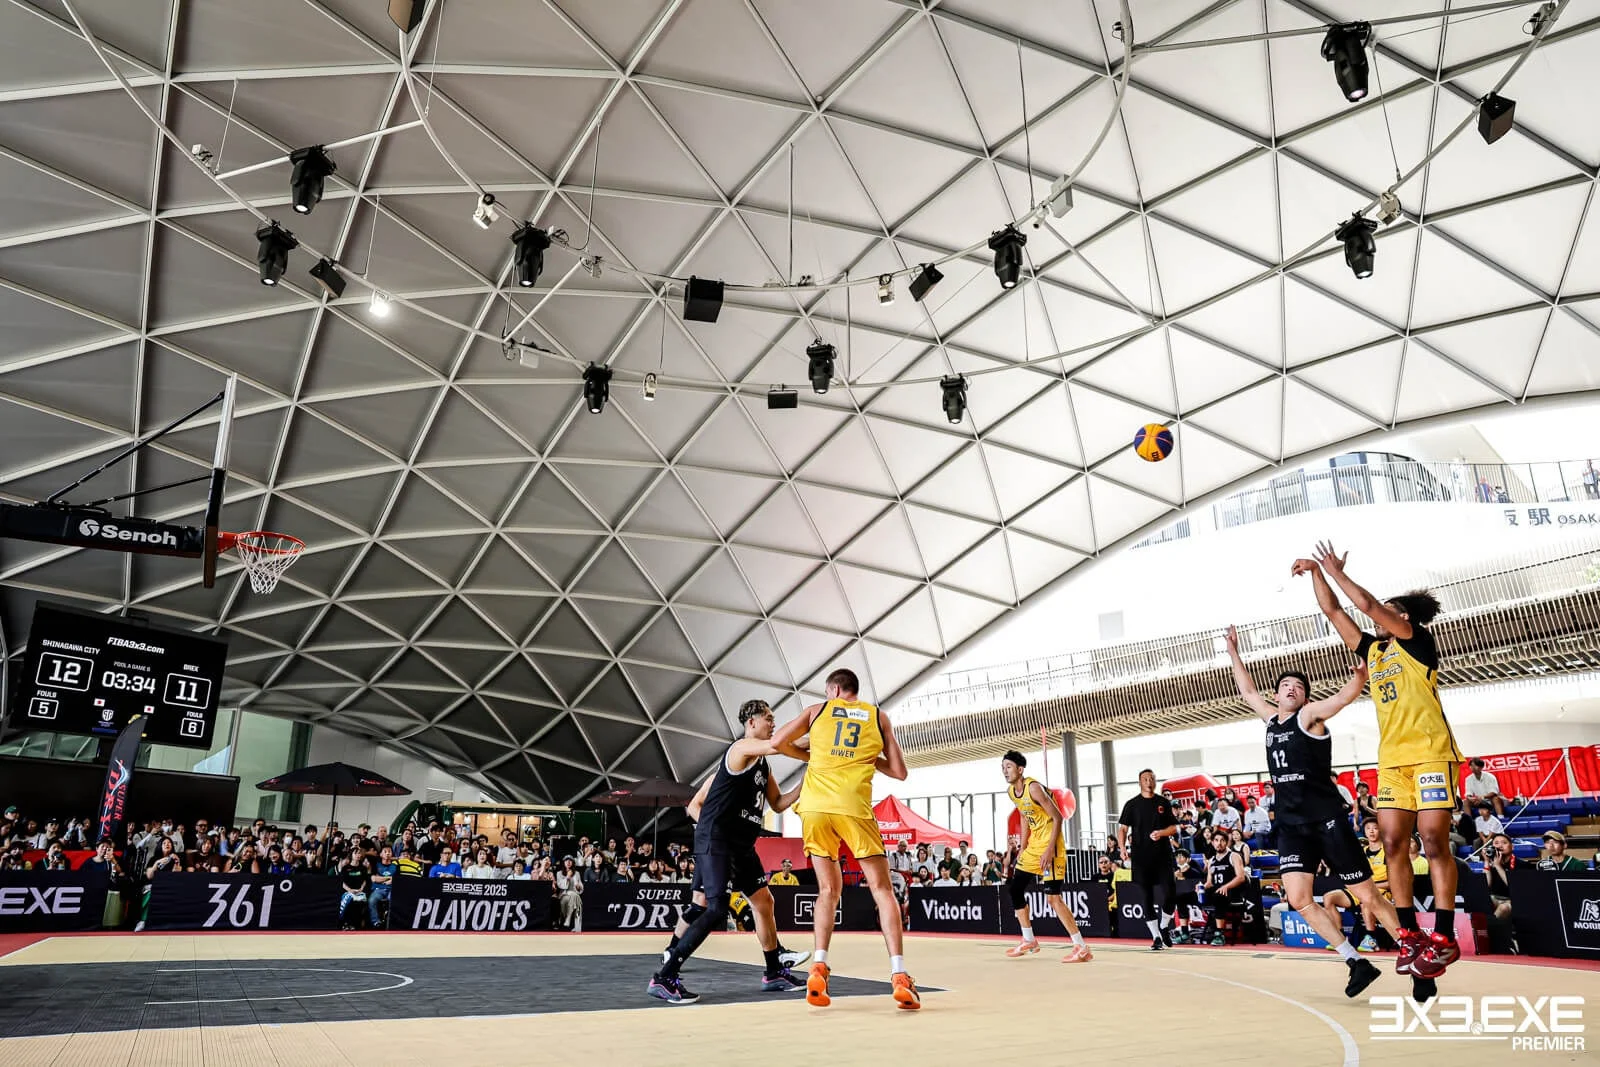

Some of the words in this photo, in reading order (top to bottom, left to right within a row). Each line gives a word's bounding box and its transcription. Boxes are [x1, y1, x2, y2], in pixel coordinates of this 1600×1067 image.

[101, 524, 177, 546] Senoh
[42, 639, 83, 652] SHINAGAWA
[84, 646, 100, 655] CITY
[107, 637, 165, 654] FIBA3x3.com
[48, 659, 81, 684] 12
[102, 671, 156, 694] 03:34
[175, 679, 198, 702] 11
[1378, 681, 1398, 704] 33
[36, 690, 57, 698] FOULS
[38, 701, 50, 715] 5
[188, 721, 198, 734] 6
[834, 721, 861, 748] 13
[1272, 749, 1289, 769] 12
[1214, 873, 1224, 884] 13
[483, 884, 508, 897] 2025
[636, 888, 682, 900] SUPER
[202, 879, 293, 928] 361°
[921, 898, 983, 921] Victoria
[412, 898, 531, 931] PLAYOFFS
